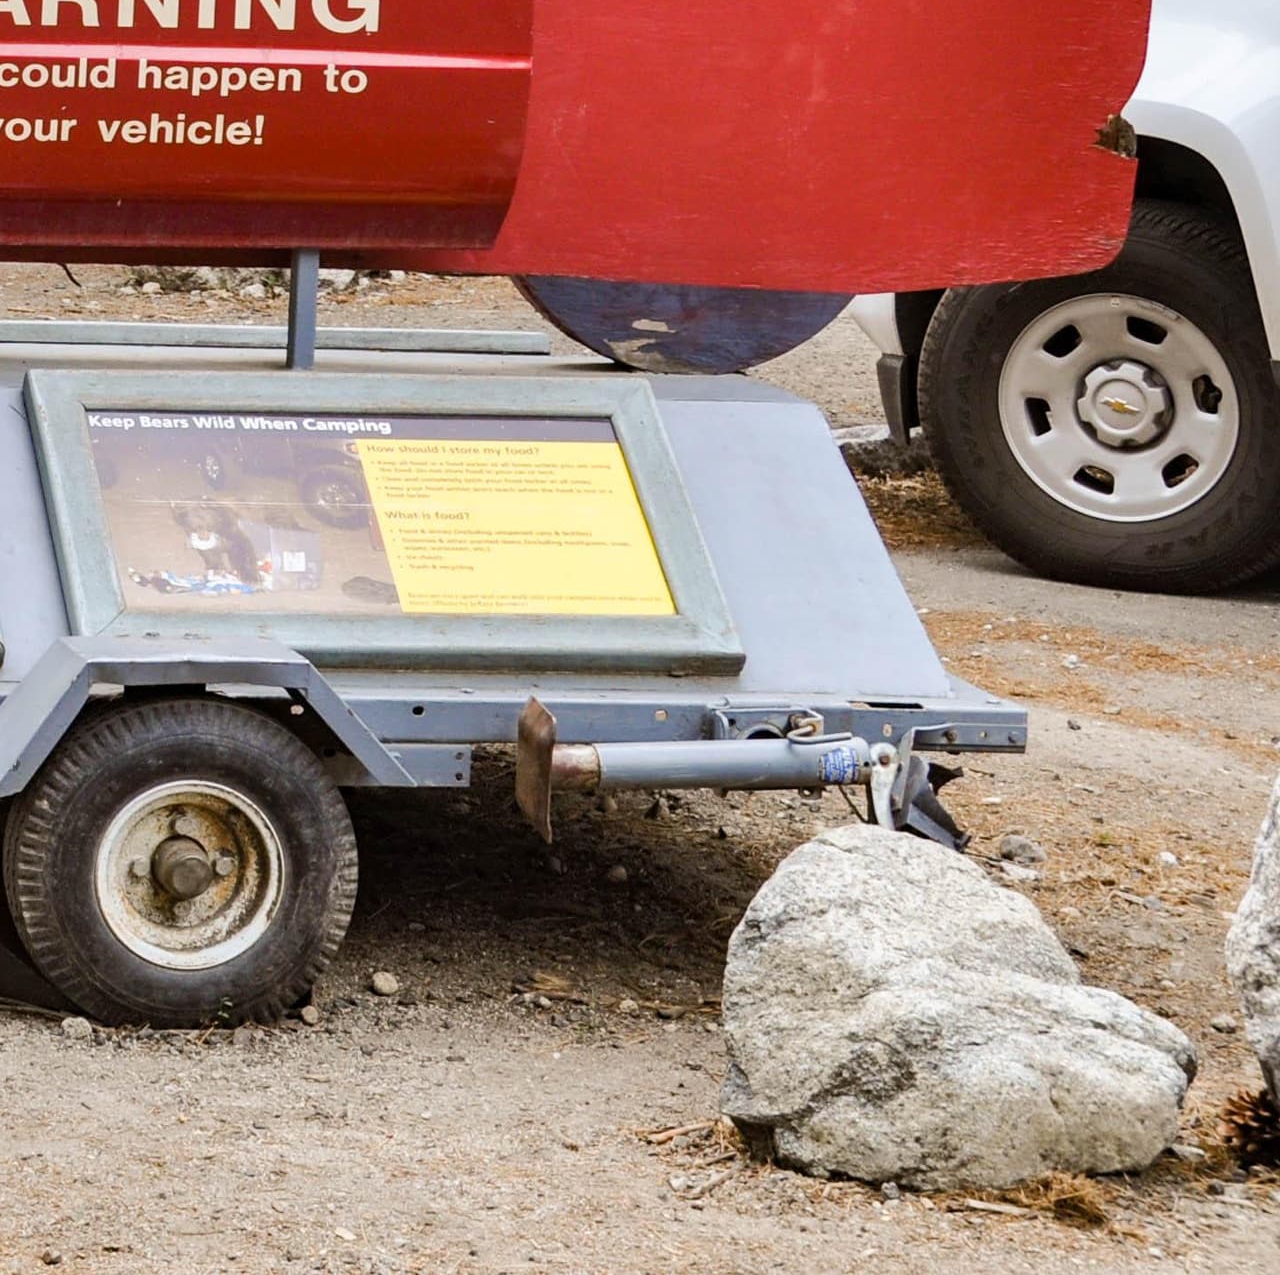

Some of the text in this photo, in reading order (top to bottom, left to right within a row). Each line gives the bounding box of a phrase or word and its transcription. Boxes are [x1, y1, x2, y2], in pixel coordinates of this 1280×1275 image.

[137, 58, 302, 96] happen
[324, 62, 368, 93] to
[97, 113, 265, 145] vehicle!
[88, 414, 391, 434] Keep Bears Wild When Camping
[398, 444, 439, 454] should
[449, 446, 480, 455] store
[483, 447, 501, 457] my
[504, 446, 540, 456] food?
[385, 511, 470, 521] What is food?
